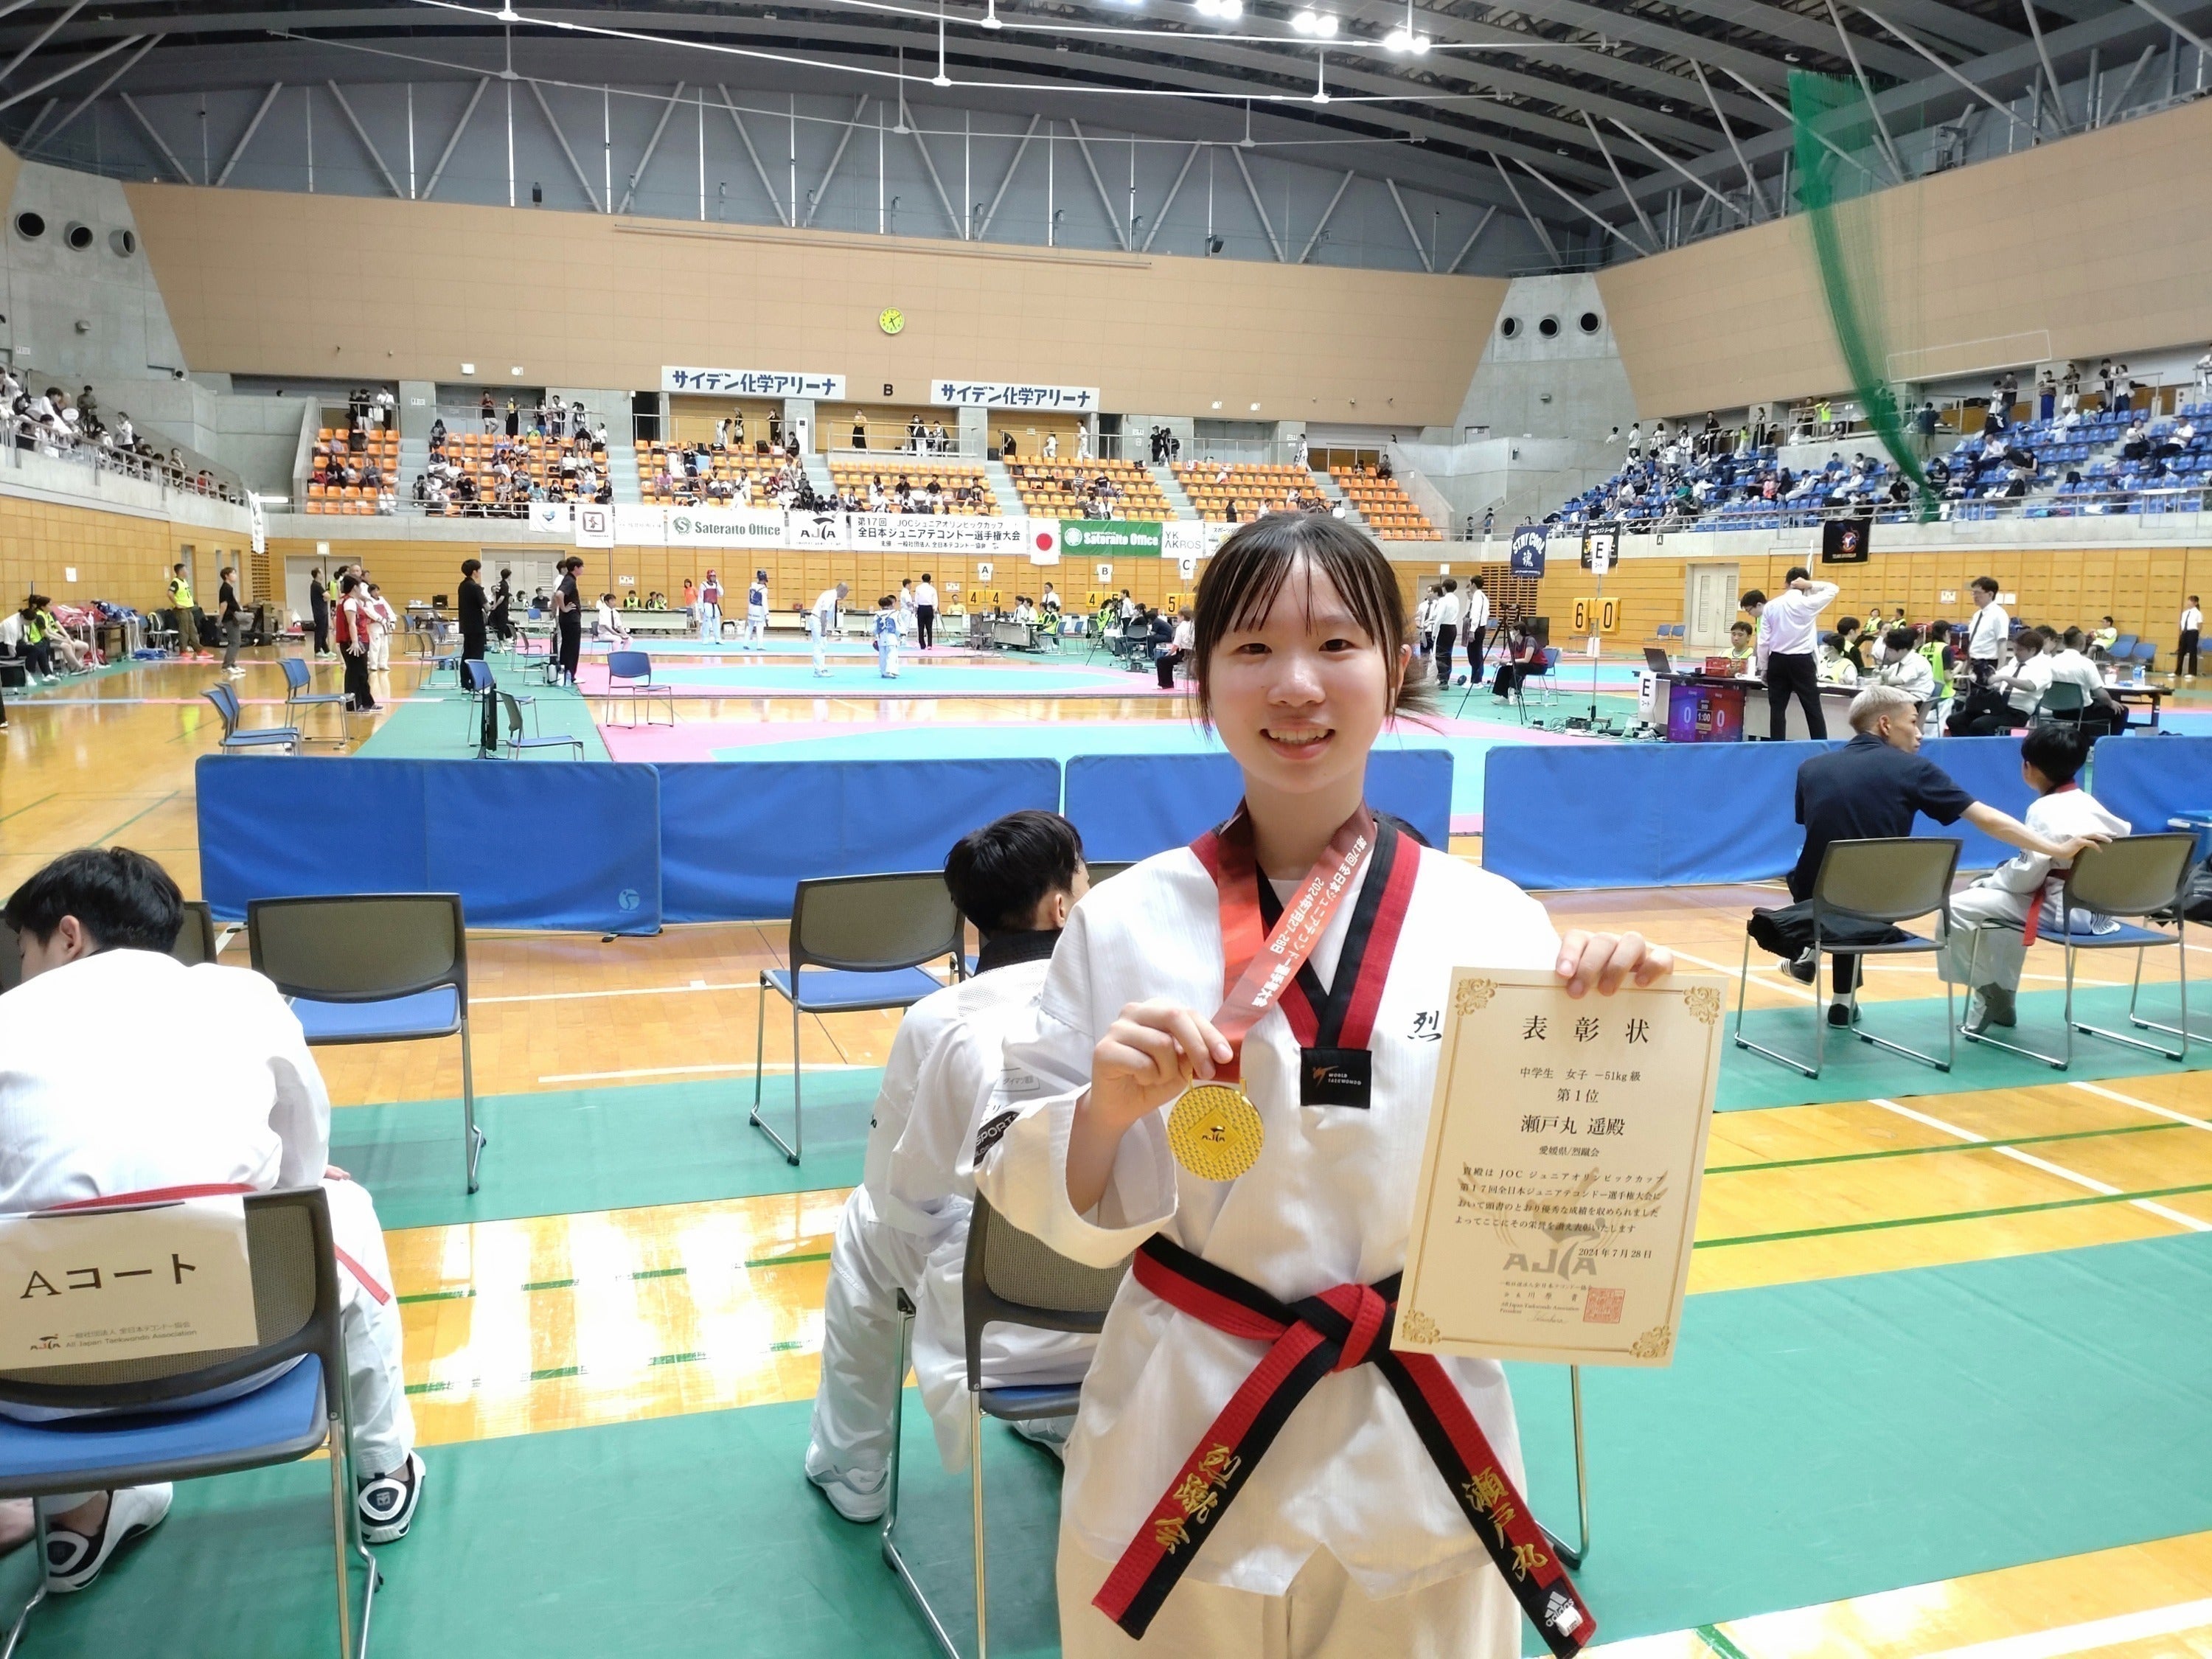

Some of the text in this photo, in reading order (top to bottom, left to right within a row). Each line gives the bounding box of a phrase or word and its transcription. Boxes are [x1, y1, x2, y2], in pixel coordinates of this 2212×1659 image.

[672, 370, 836, 396] サイデン化学アリーナ
[883, 383, 894, 396] B
[941, 383, 1091, 408] サイデン化学アリーナ
[695, 521, 781, 536] Sateraito Office
[858, 517, 887, 527] 第17回
[858, 527, 1020, 541] 全日本ジュニアテコンドー選手権大会
[1084, 532, 1159, 546] Sateraito Office
[1165, 531, 1179, 540] YK
[1657, 535, 1663, 543] A
[1513, 532, 1545, 554] STAY COOL
[1596, 542, 1604, 558] E
[1102, 567, 1108, 575] B
[1183, 560, 1190, 570] C
[970, 592, 999, 604] 4 4
[1089, 594, 1095, 605] 4
[1168, 596, 1175, 612] 5
[1575, 602, 1613, 628] 6 0
[1642, 678, 1651, 697] E
[1684, 706, 1691, 723] 0
[1697, 712, 1711, 722] 1:00
[1717, 710, 1725, 728] 0
[1407, 1010, 1442, 1042] 烈
[1522, 1015, 1649, 1044] 表彰状
[1520, 1067, 1554, 1079] 中学生
[1565, 1068, 1588, 1080] 女子
[1328, 1078, 1362, 1086] TAEKWONDO
[1557, 1088, 1599, 1103] 第1位
[1520, 1114, 1577, 1135] 瀬戸丸
[1539, 1145, 1600, 1158] 愛媛県/烈蹴会
[1498, 1169, 1523, 1179] JOC
[20, 1253, 196, 1299] Aコート
[79, 1338, 102, 1349] Japan
[105, 1335, 150, 1346] Taekwondo
[152, 1329, 198, 1340] Association
